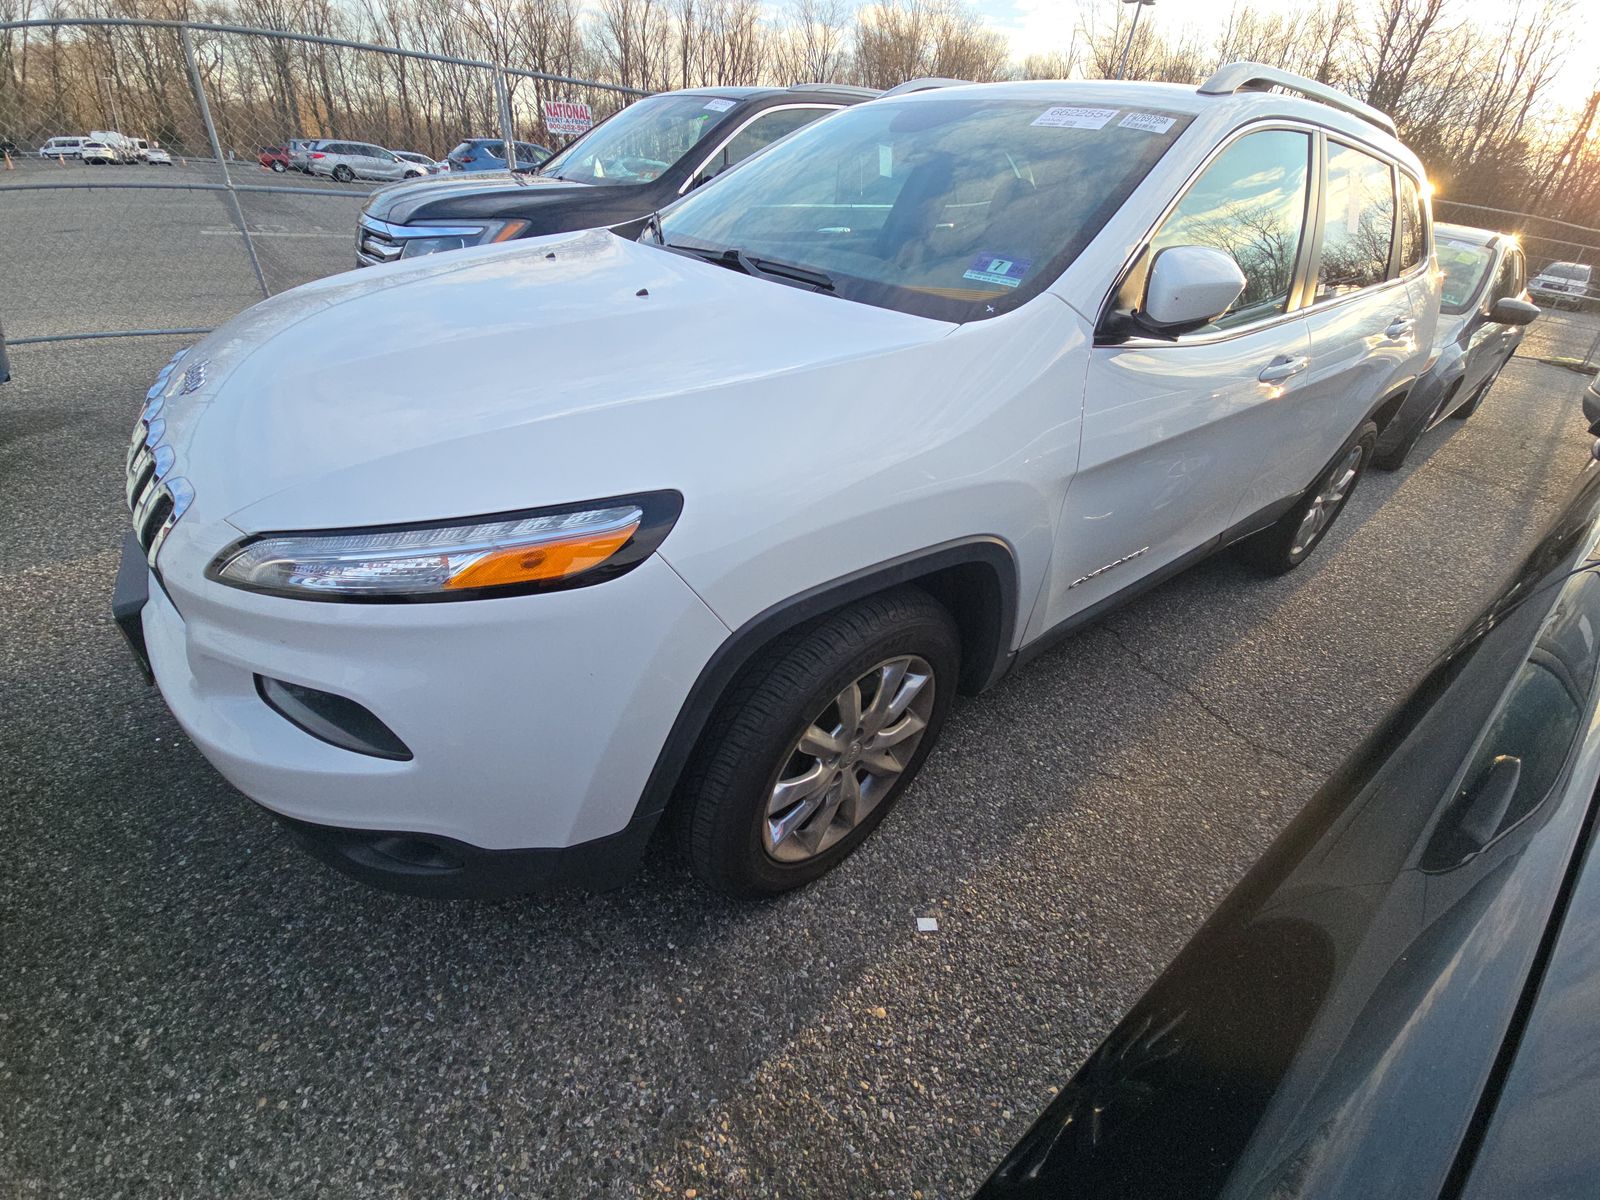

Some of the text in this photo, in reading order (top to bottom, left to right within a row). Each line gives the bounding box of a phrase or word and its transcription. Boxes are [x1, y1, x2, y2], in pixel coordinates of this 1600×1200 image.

[545, 102, 591, 120] NATIONAL
[546, 116, 592, 126] RENT-A-FENCE
[994, 261, 1005, 271] 7
